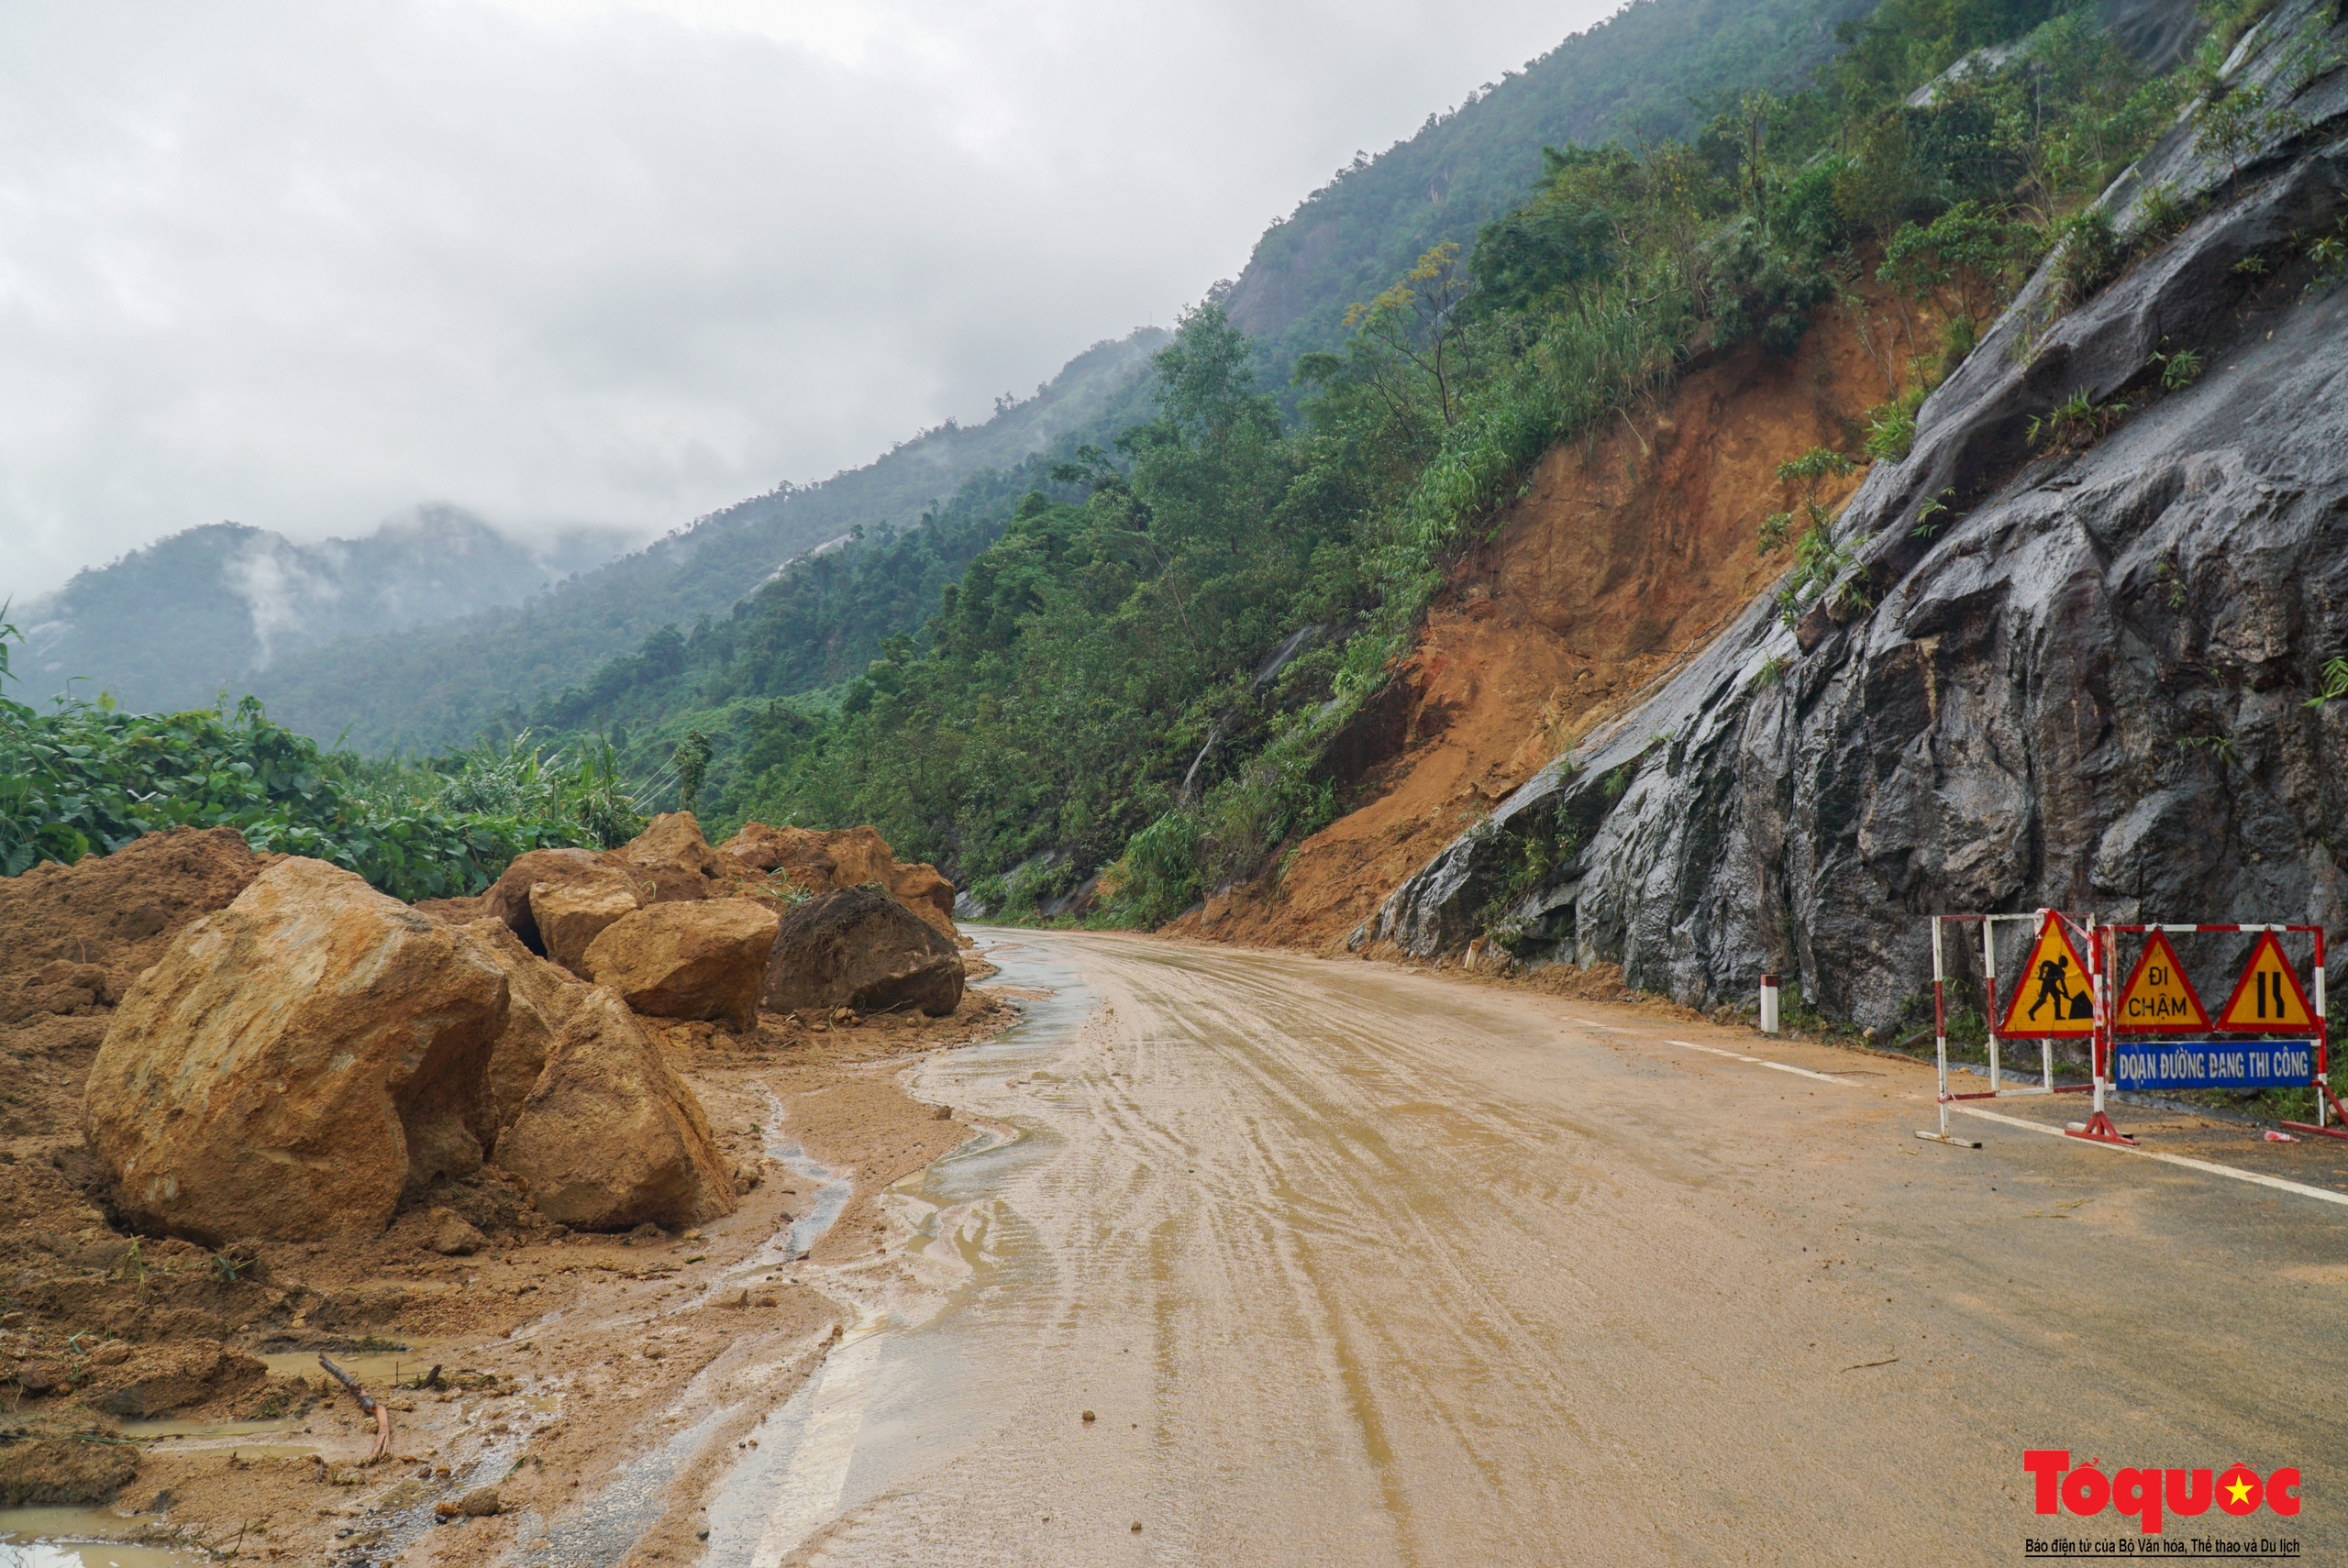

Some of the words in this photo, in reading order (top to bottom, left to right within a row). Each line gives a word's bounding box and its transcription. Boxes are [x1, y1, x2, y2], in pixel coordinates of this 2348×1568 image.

[2148, 966, 2167, 986] ĐI
[2129, 993, 2187, 1020] CHẬM
[2119, 1054, 2156, 1085] ĐOẠN
[2160, 1046, 2205, 1078] ĐƯỜNG
[2210, 1052, 2244, 1078] ĐANG
[2249, 1052, 2270, 1077] THI
[2274, 1045, 2309, 1077] CÔNG
